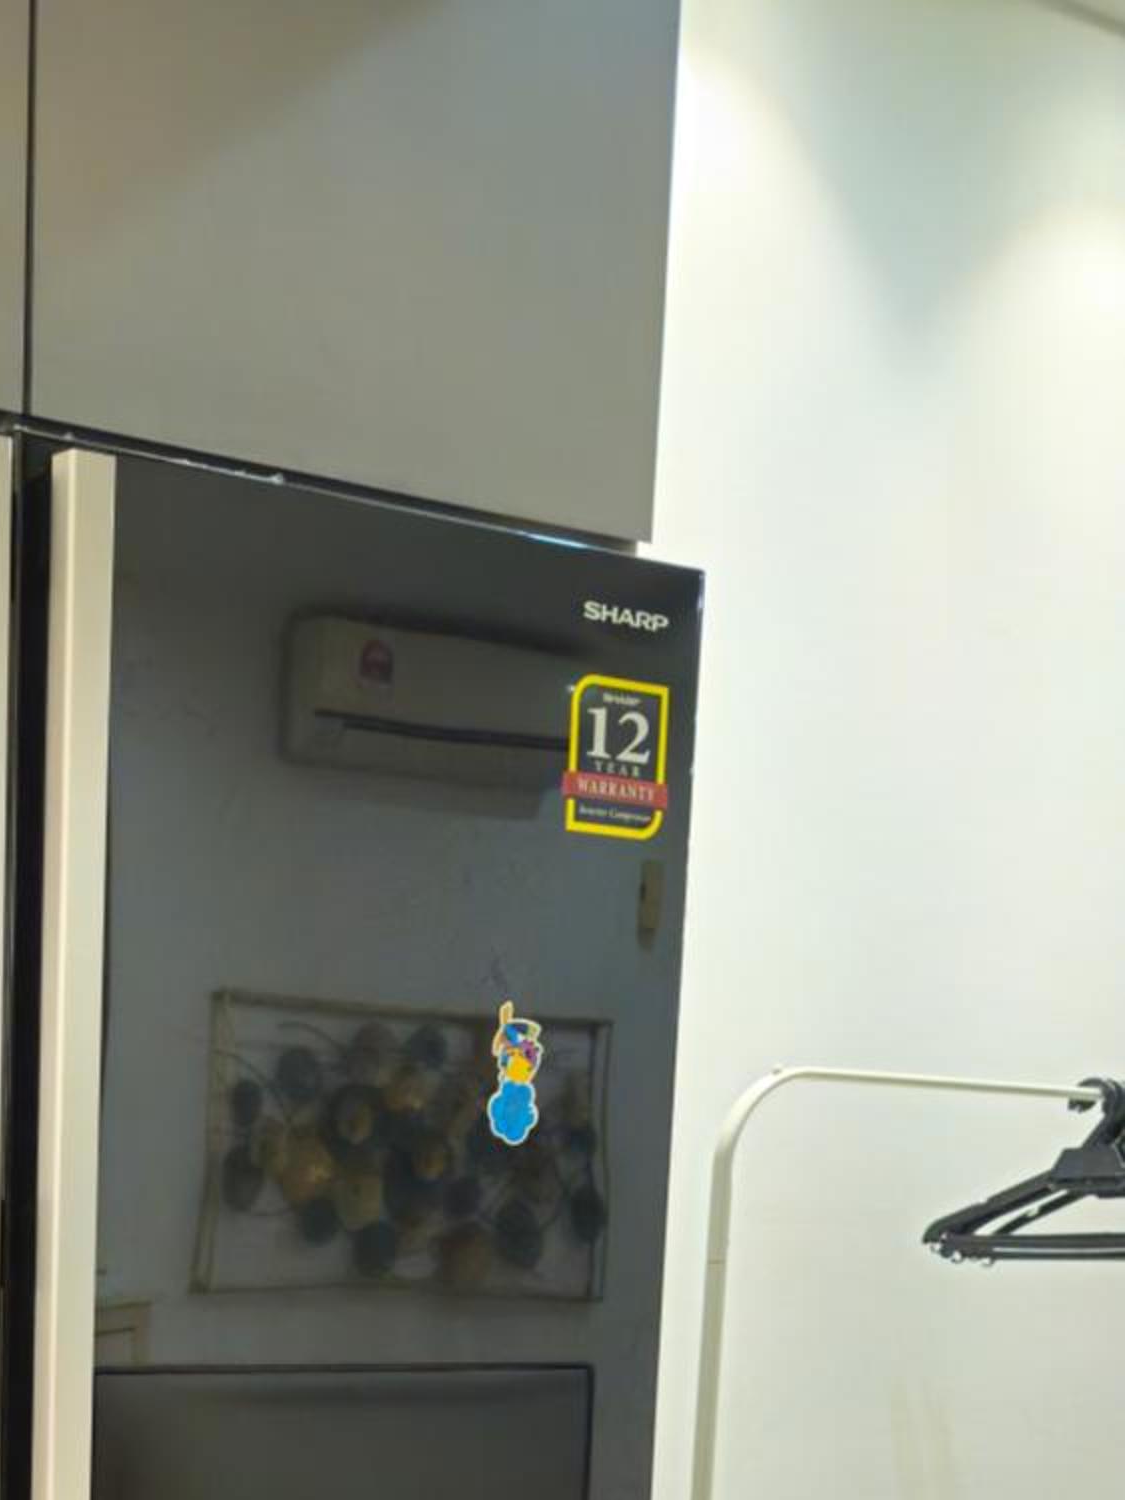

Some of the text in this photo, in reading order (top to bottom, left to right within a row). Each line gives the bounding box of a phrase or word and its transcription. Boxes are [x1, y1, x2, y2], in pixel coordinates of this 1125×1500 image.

[583, 600, 669, 632] SHARP
[586, 706, 651, 765] 12
[594, 760, 641, 778] YEAR
[576, 777, 655, 801] WARRANTY
